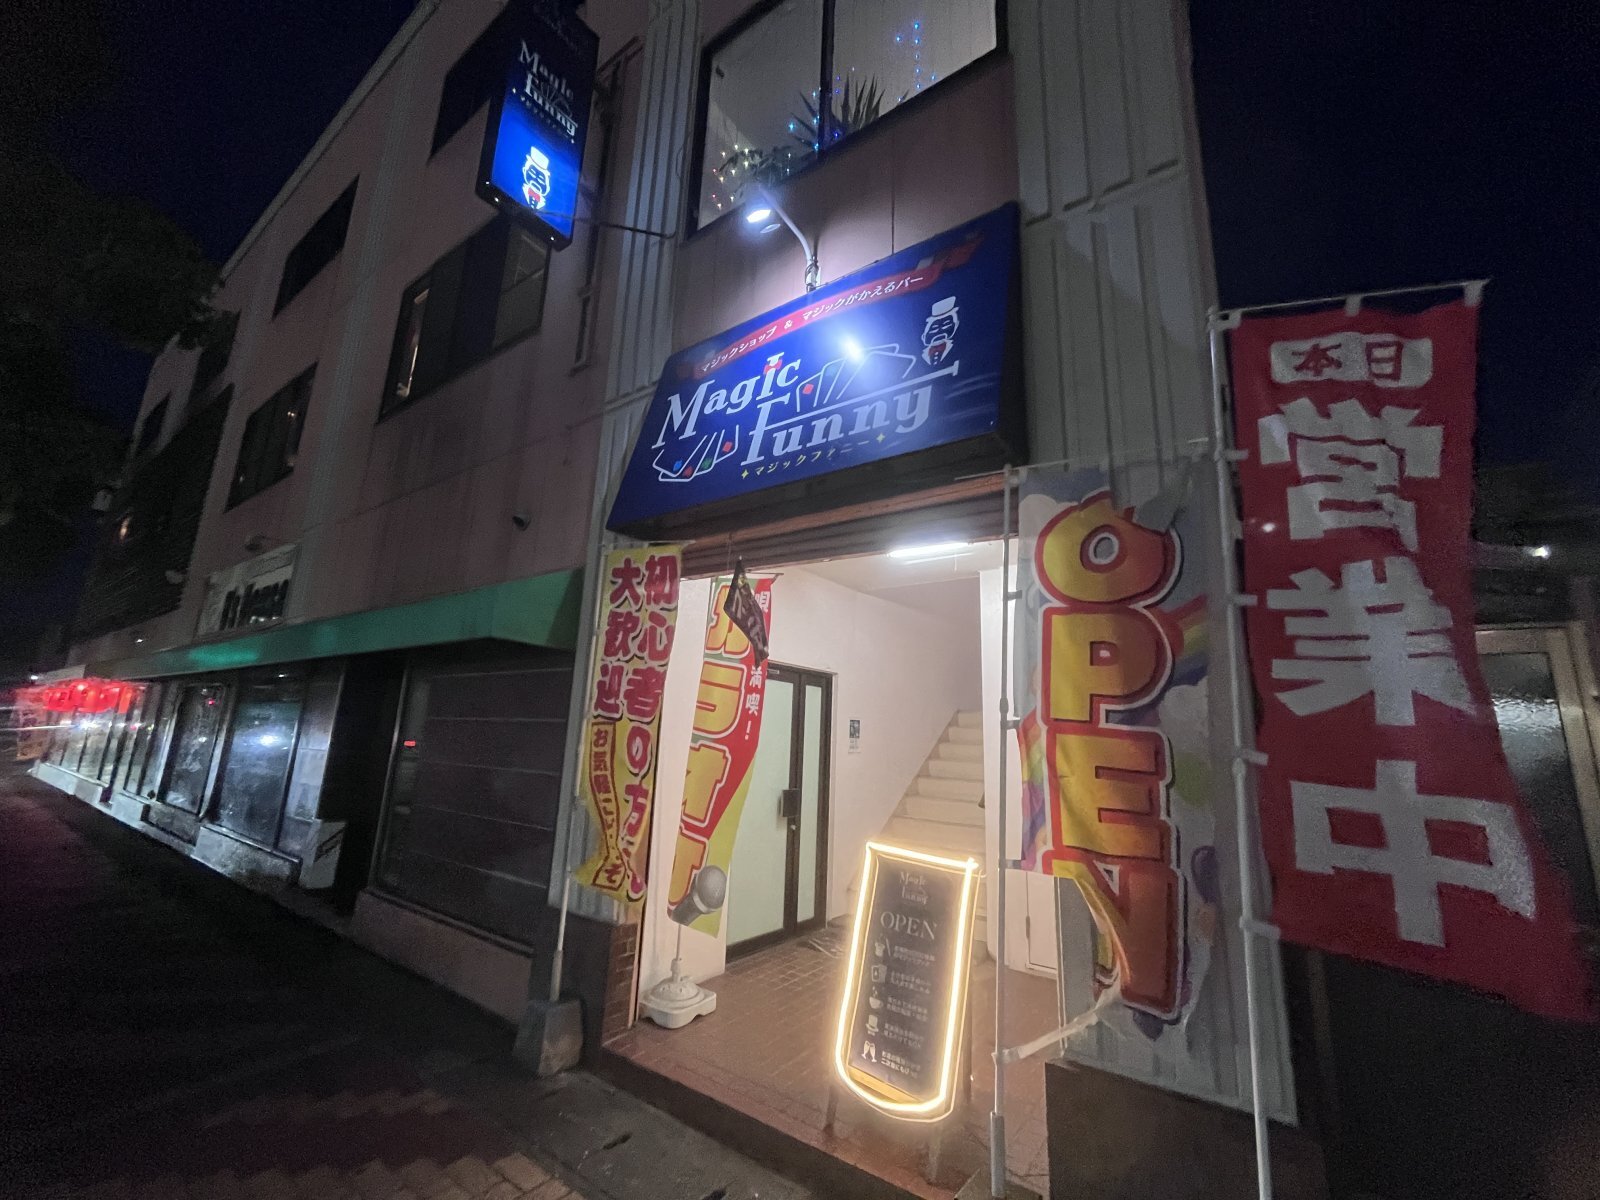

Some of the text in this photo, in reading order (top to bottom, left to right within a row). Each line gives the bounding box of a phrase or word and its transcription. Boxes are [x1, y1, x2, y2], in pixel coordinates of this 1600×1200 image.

[783, 318, 794, 331] &
[802, 275, 924, 322] マジックがかえるバー
[651, 351, 802, 450] Magic
[1292, 340, 1404, 381] 本日
[741, 364, 957, 466] Funny
[755, 440, 871, 476] マジックファニー
[593, 556, 642, 714] 大歓迎
[1258, 396, 1536, 948] 営業中
[624, 555, 678, 894] 初心者の方
[880, 911, 938, 941] OPEN
